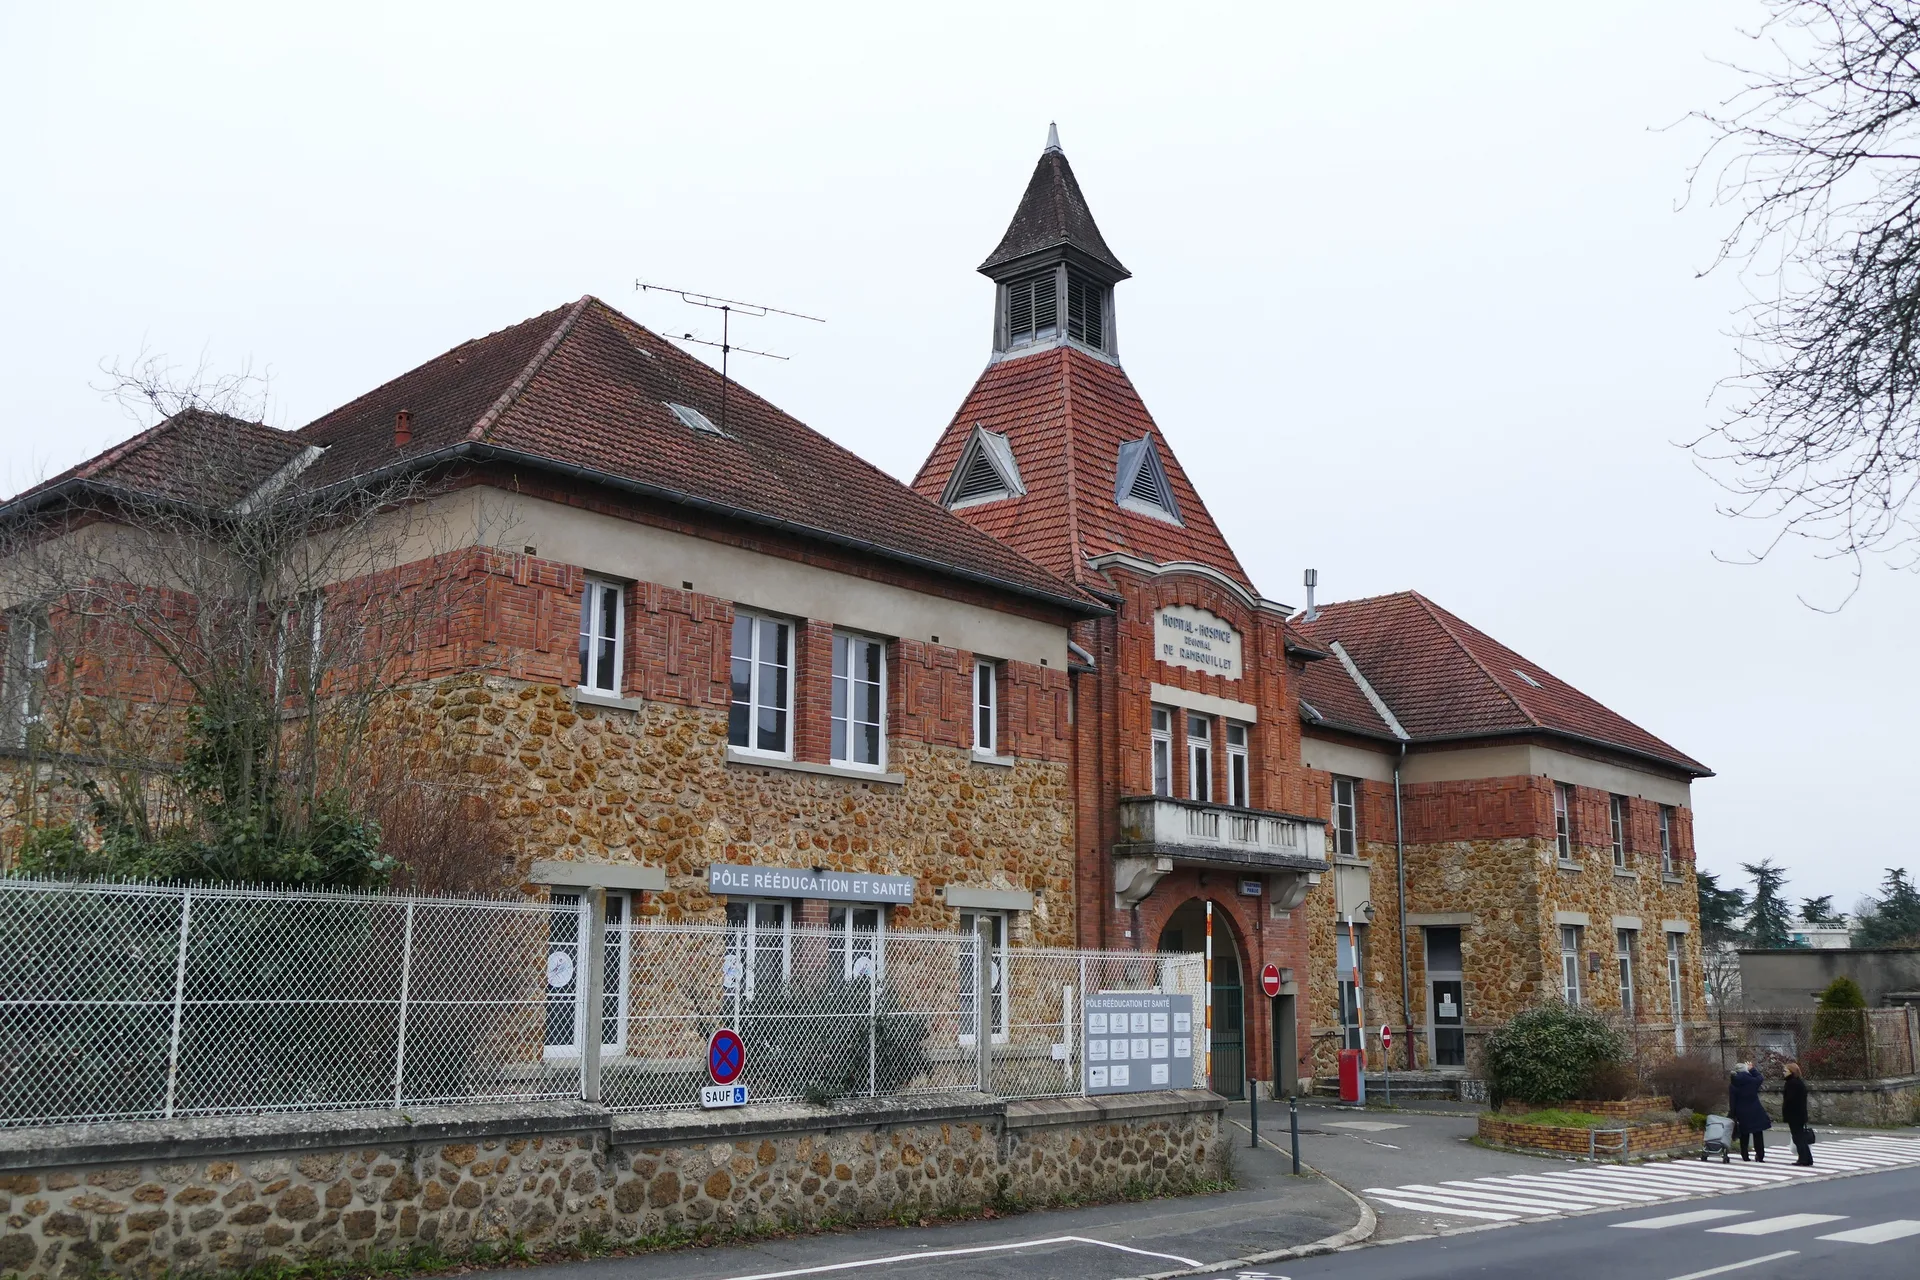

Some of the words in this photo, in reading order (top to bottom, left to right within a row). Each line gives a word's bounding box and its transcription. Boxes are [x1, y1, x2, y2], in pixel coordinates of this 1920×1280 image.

[1184, 636, 1211, 650] REGIONAL
[1163, 643, 1173, 655] DE
[1179, 648, 1231, 669] RAMBOUILLET
[712, 869, 749, 887] PÔLE
[754, 872, 849, 893] RÉÉDUCATION
[853, 881, 869, 894] ET
[872, 881, 911, 896] SANTÉ
[1085, 998, 1102, 1008] PÔLE
[1102, 998, 1143, 1008] RÉÉDUCATION
[1143, 999, 1151, 1008] ET
[1151, 998, 1170, 1008] SANTÉ
[705, 1091, 730, 1102] SAUF
